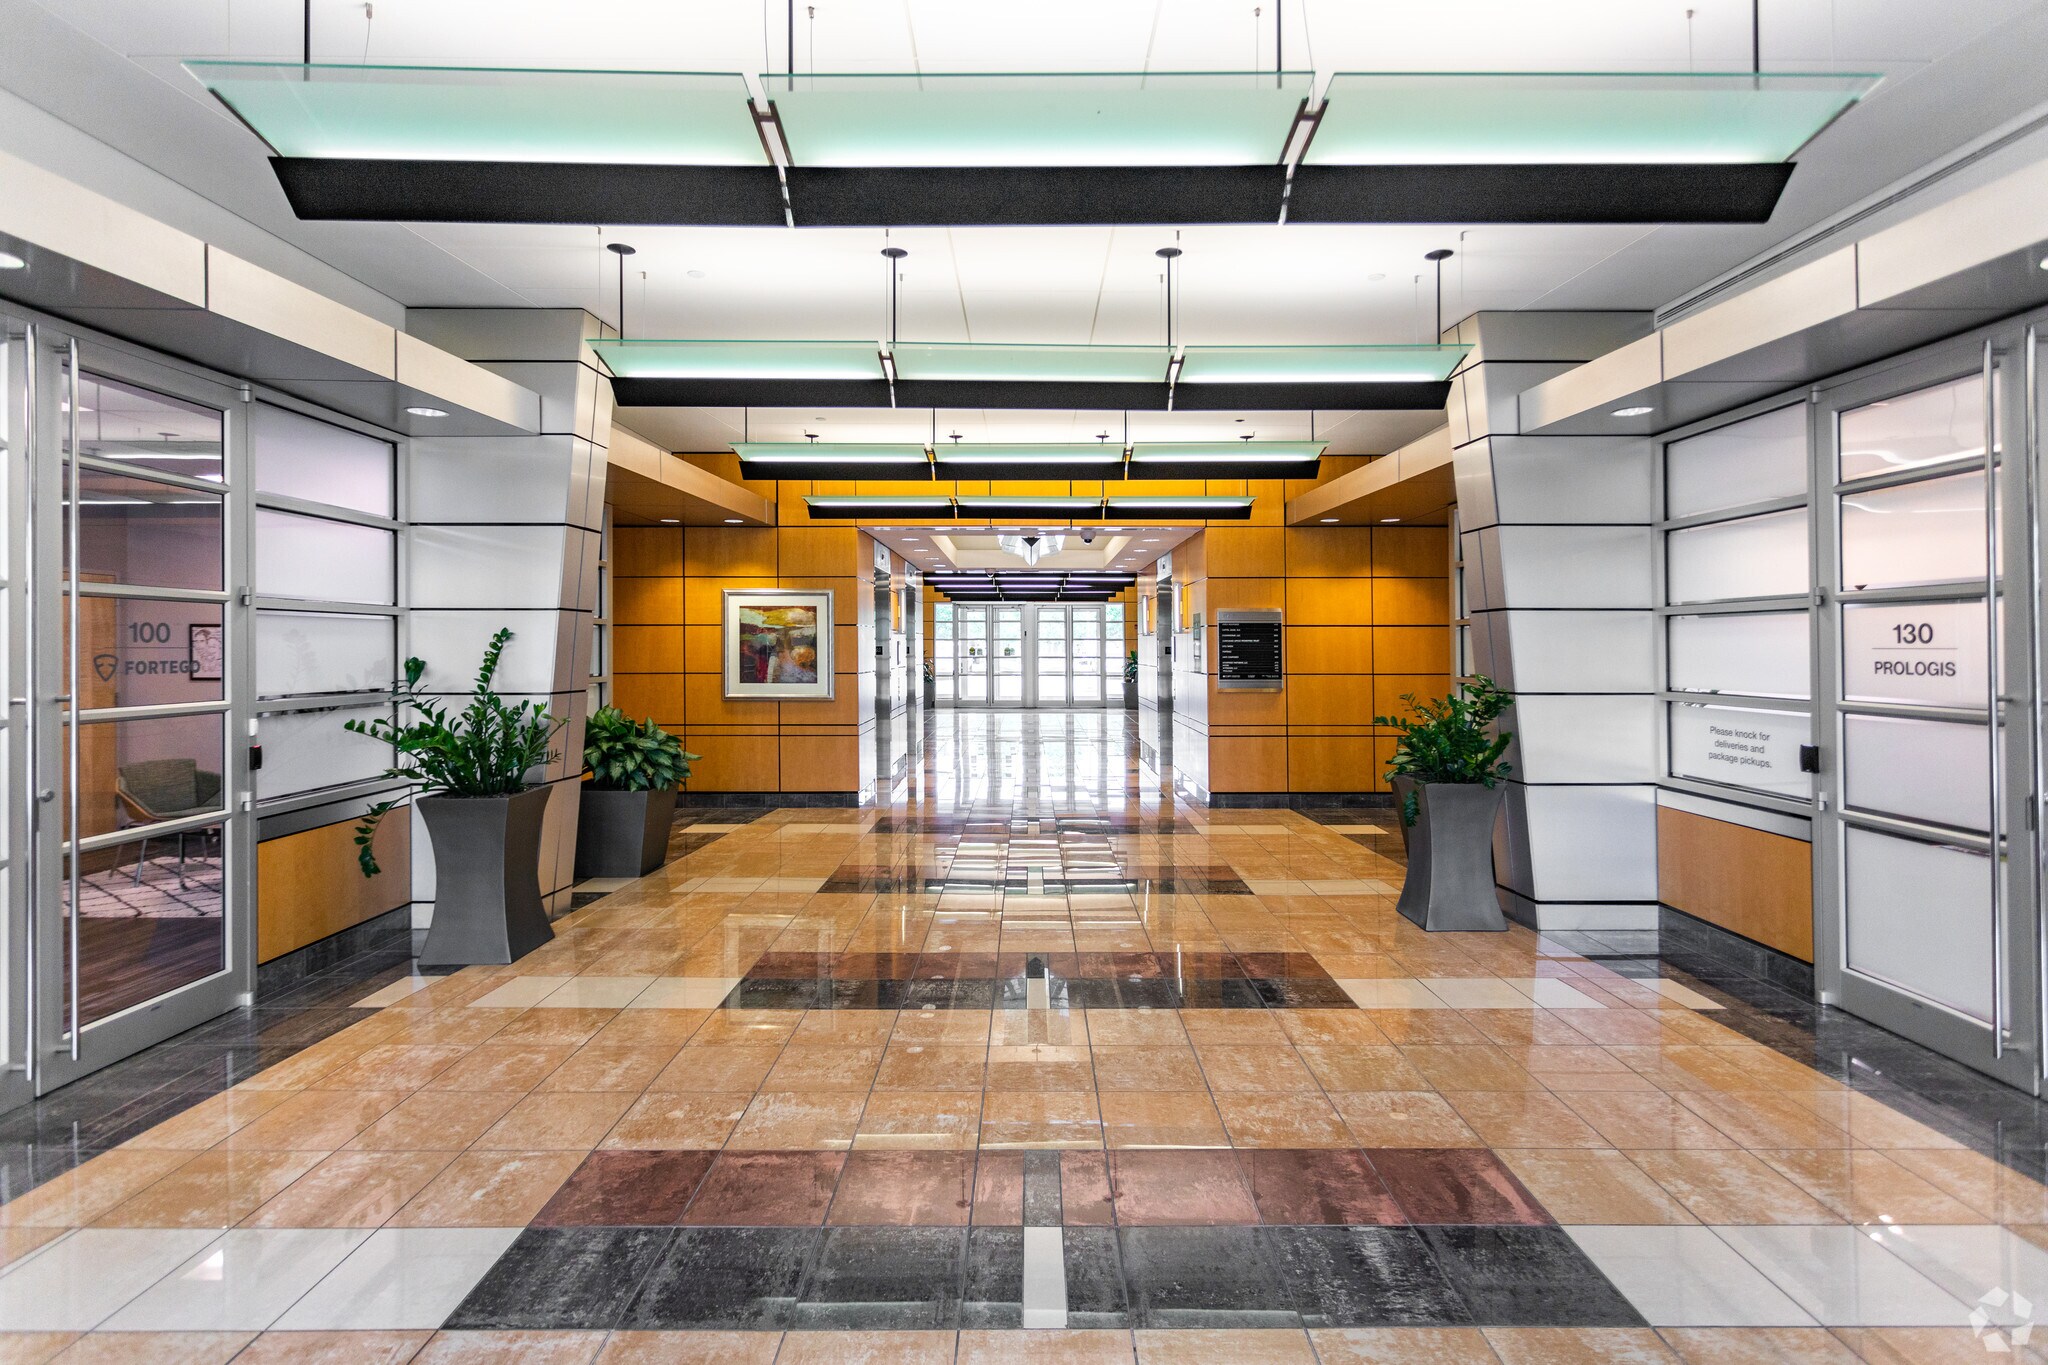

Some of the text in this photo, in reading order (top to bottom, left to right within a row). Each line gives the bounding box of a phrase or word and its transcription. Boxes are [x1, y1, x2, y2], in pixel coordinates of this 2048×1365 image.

[128, 621, 171, 643] 100
[1892, 623, 1933, 644] 130
[124, 660, 201, 675] FORTEGO
[1874, 661, 1957, 677] PROLOGIS
[1710, 726, 1770, 741] Please knock for
[1715, 740, 1764, 754] deliveries and
[1708, 752, 1772, 768] package pickups.
